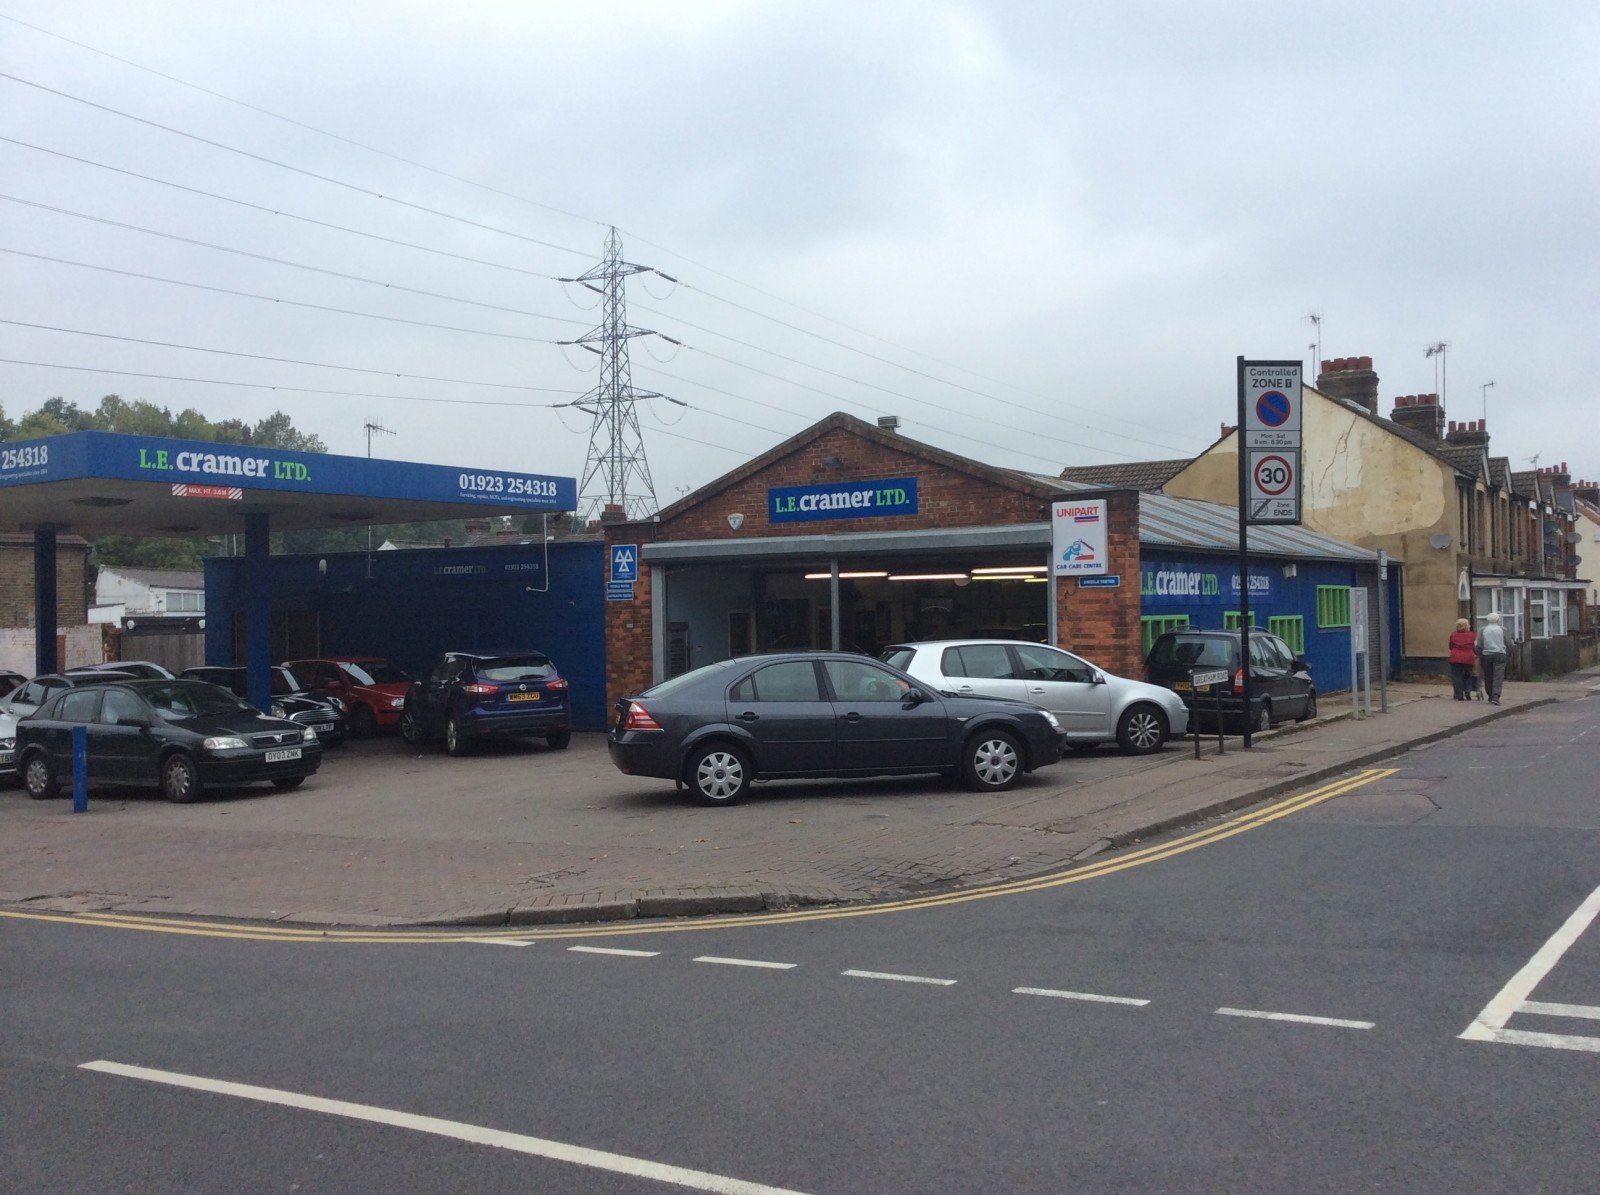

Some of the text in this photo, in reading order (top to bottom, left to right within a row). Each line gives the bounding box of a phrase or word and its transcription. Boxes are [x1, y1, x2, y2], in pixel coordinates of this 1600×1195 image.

[1250, 368, 1297, 376] Controlled
[1252, 379, 1283, 388] ZONE
[2, 445, 48, 470] 254318
[139, 449, 311, 481] L.E. cramer LTD.
[1261, 467, 1286, 484] 30
[459, 473, 557, 496] 01923 254318
[776, 488, 910, 513] L.E. cramer LTD.
[1056, 506, 1099, 517] UNIPART
[443, 565, 473, 574] cramer
[1156, 571, 1200, 595] cramer
[1202, 573, 1220, 595] LTD.
[1217, 671, 1228, 681] ROAD
[268, 750, 299, 760] OY03 ZNK
